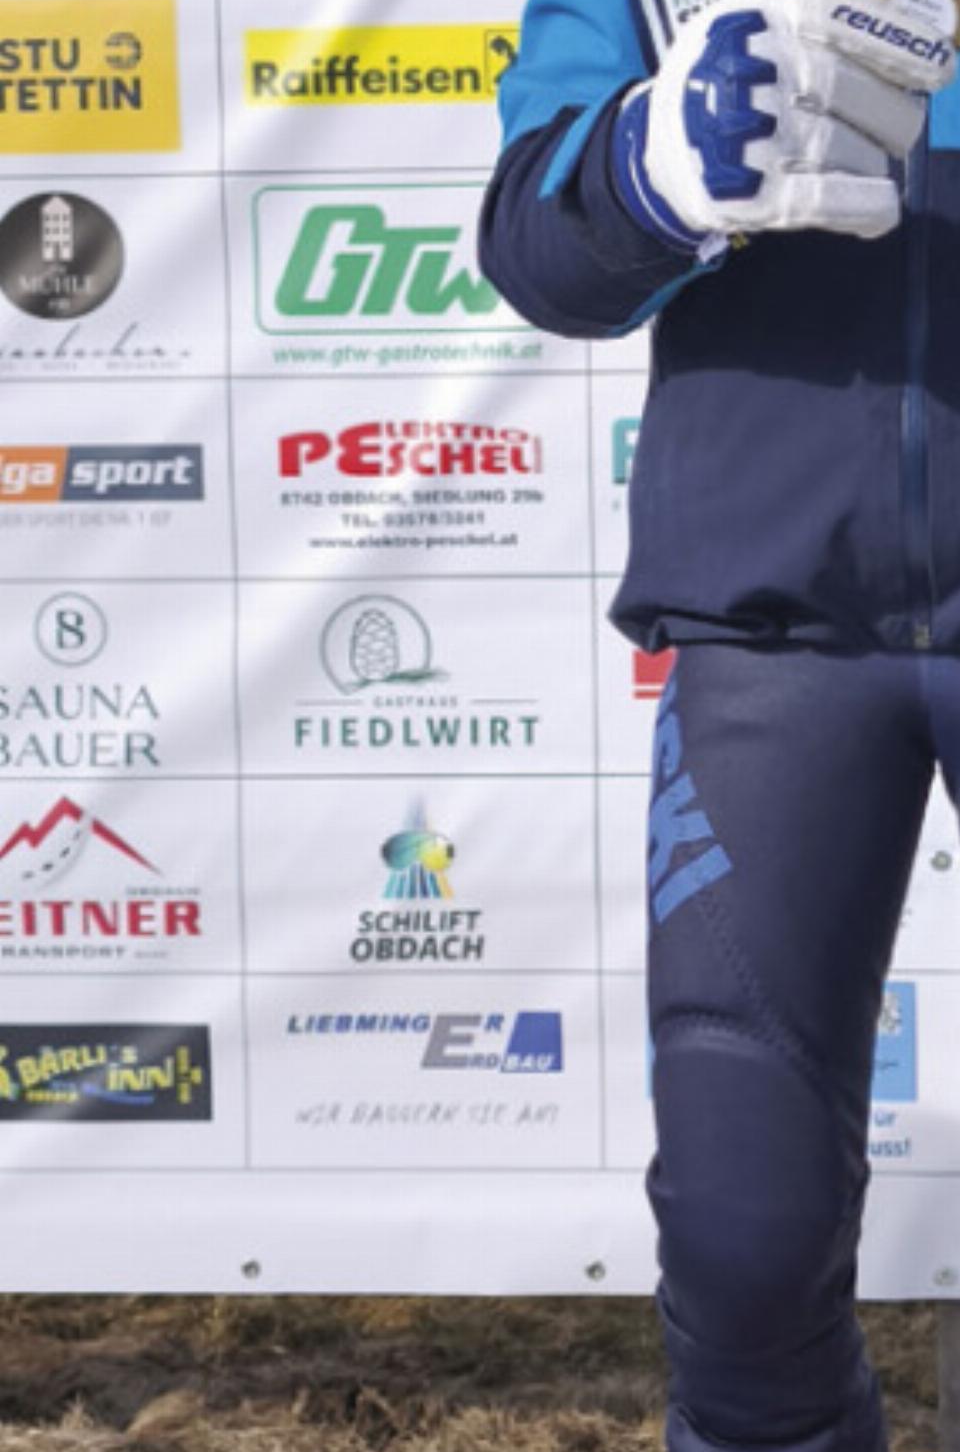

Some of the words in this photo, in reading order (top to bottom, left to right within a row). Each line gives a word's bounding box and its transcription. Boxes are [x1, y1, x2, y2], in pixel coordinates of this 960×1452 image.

[831, 5, 951, 67] reusch
[251, 55, 481, 98] Raiffeisen
[71, 455, 194, 494] sport
[413, 490, 506, 504] SIEDLUNG
[294, 715, 540, 748] FIEDLWIRT
[358, 910, 483, 934] SCHILIFT
[350, 935, 486, 963] OBDACH
[107, 1056, 175, 1092] INN
